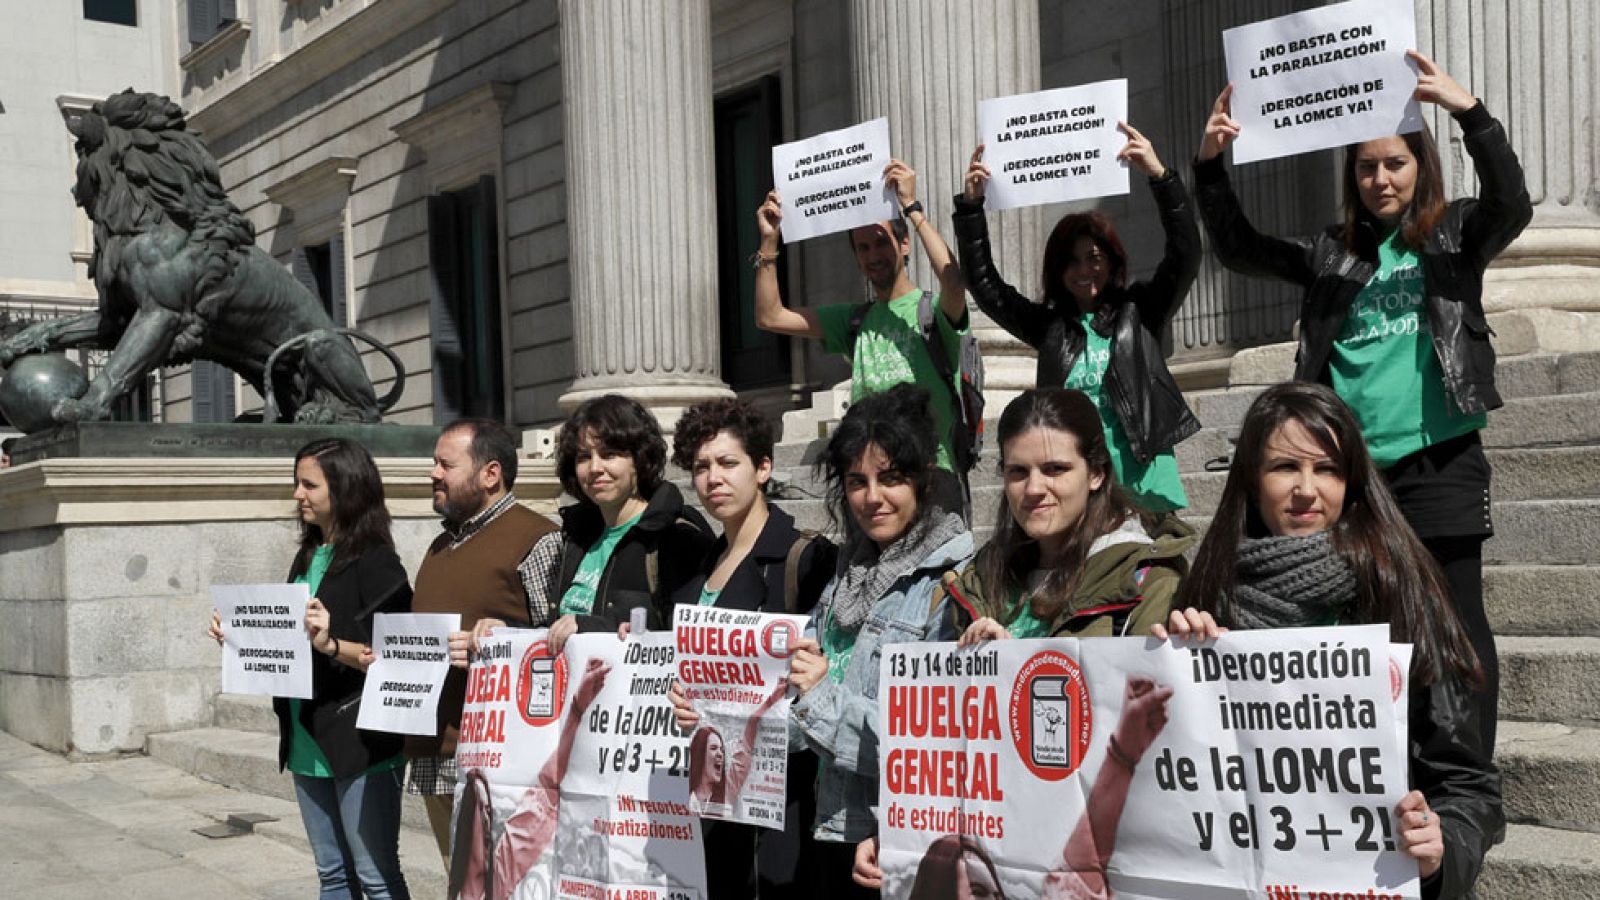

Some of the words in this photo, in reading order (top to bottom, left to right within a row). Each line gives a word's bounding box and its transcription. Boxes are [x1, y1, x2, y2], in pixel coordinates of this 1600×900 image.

[1260, 44, 1286, 61] ¡NO
[1289, 32, 1336, 53] BASTA
[1340, 25, 1372, 40] CON
[1250, 66, 1269, 79] LA
[1272, 40, 1386, 75] PARALIZACIÓN!
[1261, 83, 1359, 116] ¡DEROGACIÓN
[1363, 79, 1384, 93] DE
[1006, 115, 1027, 128] ¡NO
[1029, 109, 1068, 123] BASTA
[1071, 104, 1095, 117] CON
[1274, 116, 1291, 129] LA
[1295, 105, 1343, 125] LOMCE
[1348, 99, 1373, 114] YA!
[997, 133, 1012, 143] LA
[1015, 118, 1105, 140] PARALIZACIÓN!
[788, 172, 800, 181] LA
[802, 153, 873, 178] PARALIZACIÓN!
[795, 156, 812, 168] ¡NO
[813, 148, 844, 163] BASTA
[846, 142, 865, 154] CON
[1003, 151, 1082, 173] ¡DEROGACIÓN
[1084, 149, 1100, 159] DE
[1013, 174, 1028, 184] LA
[1029, 167, 1069, 182] LOMCE
[1071, 165, 1092, 176] YA!
[795, 184, 857, 208] ¡DEROGACIÓN
[858, 181, 872, 191] DE
[804, 208, 816, 217] LA
[818, 200, 849, 214] LOMCE
[849, 196, 867, 207] YA!
[232, 618, 241, 628] LA
[248, 605, 273, 615] BASTA
[274, 605, 290, 615] CON
[679, 608, 691, 622] 13
[693, 611, 700, 624] y
[704, 610, 717, 623] 14
[718, 612, 733, 624] de
[734, 613, 762, 624] abril
[399, 636, 424, 646] BASTA
[424, 636, 440, 646] CON
[677, 625, 759, 657] HUELGA
[244, 662, 253, 672] LA
[254, 662, 276, 673] LOMCE
[285, 650, 294, 660] DE
[382, 650, 391, 659] LA
[623, 642, 675, 667] ¡Deroga
[890, 653, 906, 677] 13
[911, 657, 921, 680] y
[924, 653, 941, 677] 14
[946, 653, 963, 677] de
[966, 651, 998, 677] abril
[1191, 641, 1372, 684] ¡Derogación
[679, 660, 765, 687] GENERAL
[383, 696, 393, 706] LA
[423, 684, 433, 693] DE
[686, 687, 700, 699] de
[703, 687, 764, 705] estudiantes
[589, 704, 609, 734] de
[615, 705, 633, 735] la
[633, 705, 692, 738] LOMC
[888, 685, 1002, 740] HUELGA
[1219, 694, 1377, 730] inmediata
[599, 747, 609, 774] y
[613, 742, 630, 772] el
[629, 742, 642, 773] 3
[667, 745, 690, 778] 2!
[1155, 748, 1198, 792] de
[1209, 747, 1247, 792] la
[1255, 747, 1385, 795] LOMCE
[886, 748, 1003, 802] GENERAL
[617, 794, 637, 812] ¡Ni
[887, 802, 905, 829] de
[910, 805, 1004, 839] estudiantes
[1192, 812, 1213, 851] y
[1228, 804, 1260, 850] el
[1270, 805, 1297, 851] 3
[1305, 813, 1343, 851] +
[1351, 806, 1396, 852] 2!
